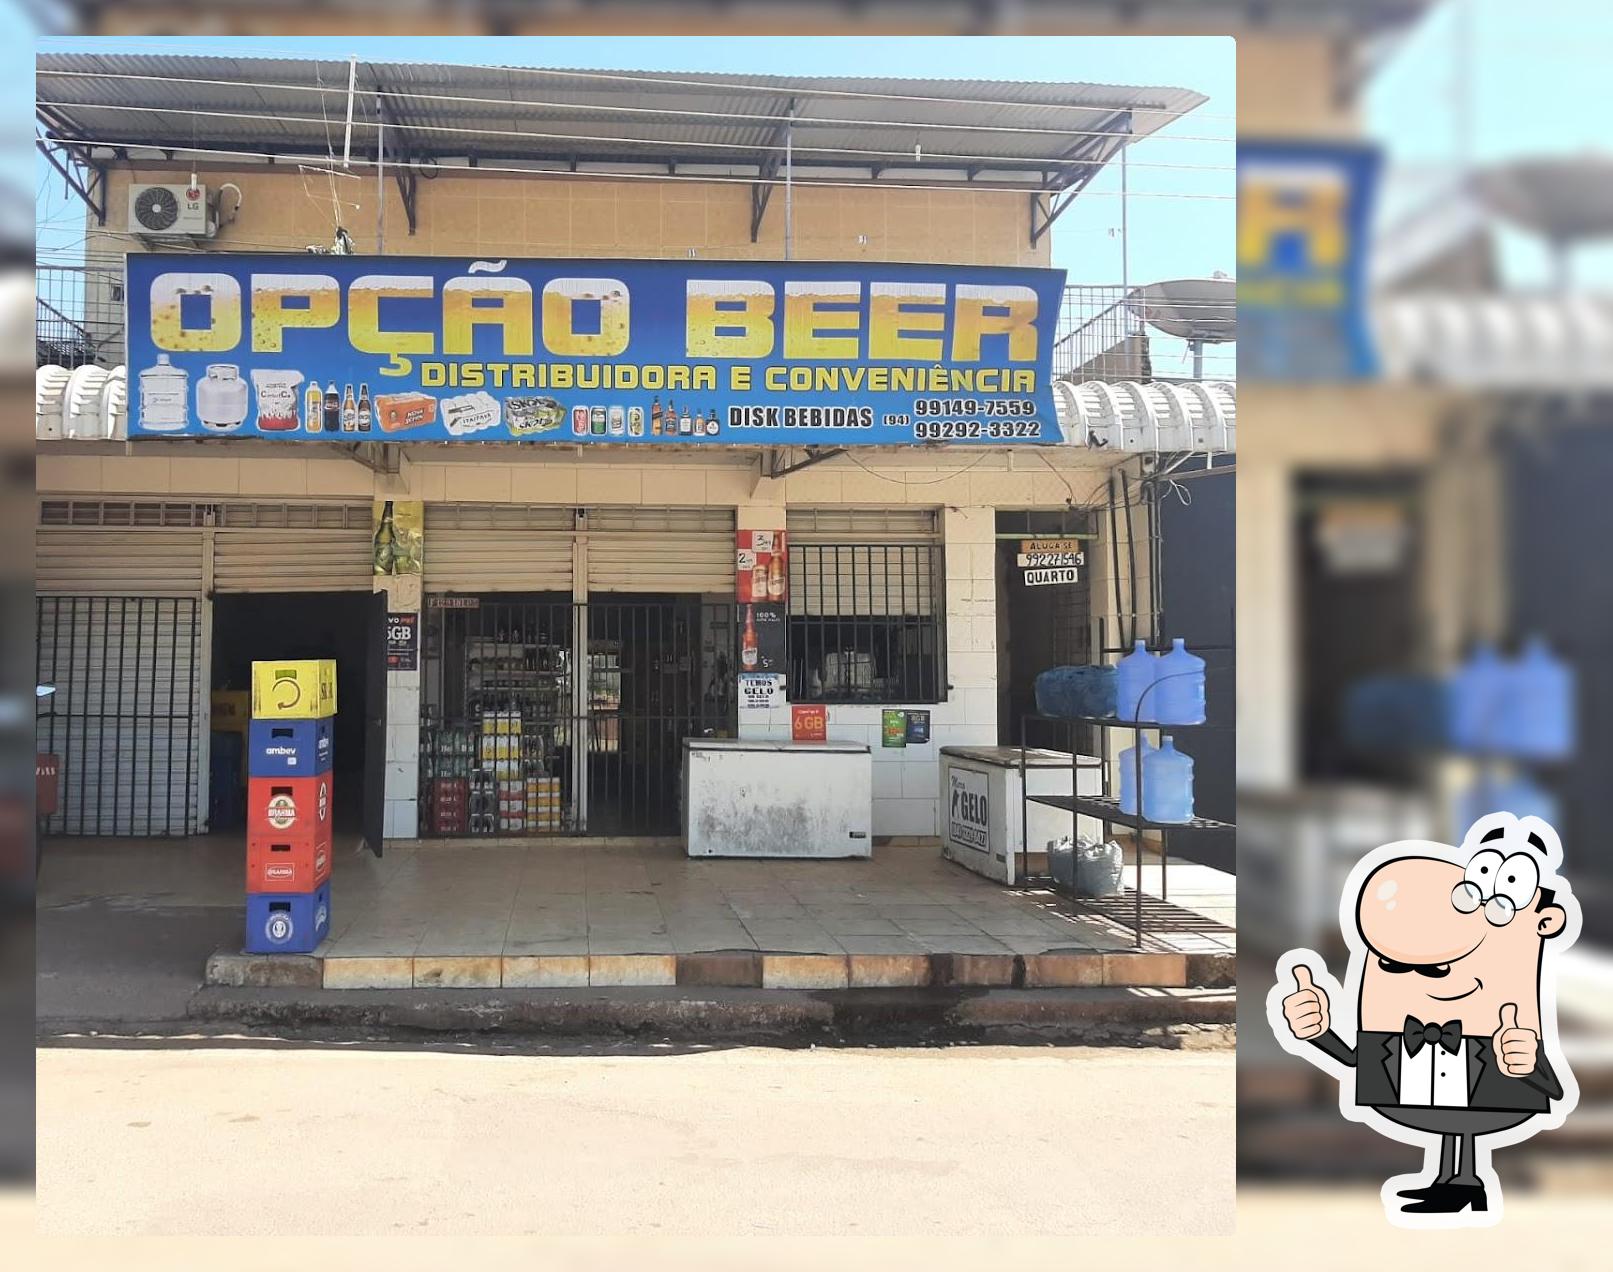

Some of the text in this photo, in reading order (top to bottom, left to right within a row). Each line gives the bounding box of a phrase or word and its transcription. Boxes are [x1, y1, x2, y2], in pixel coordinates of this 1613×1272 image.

[150, 259, 1039, 377] OPÇÃO BEER
[421, 361, 1037, 393] DISTRIBUIDORA E CONVENIÊNCIA
[914, 399, 1036, 416] 99149-7559
[729, 406, 910, 428] DISK BEBIDAS (94)
[914, 421, 1041, 438] 99292-3322
[1026, 569, 1075, 584] QUARTO
[794, 716, 824, 729] 6 GB
[266, 746, 297, 756] ambev
[961, 790, 987, 827] GELO
